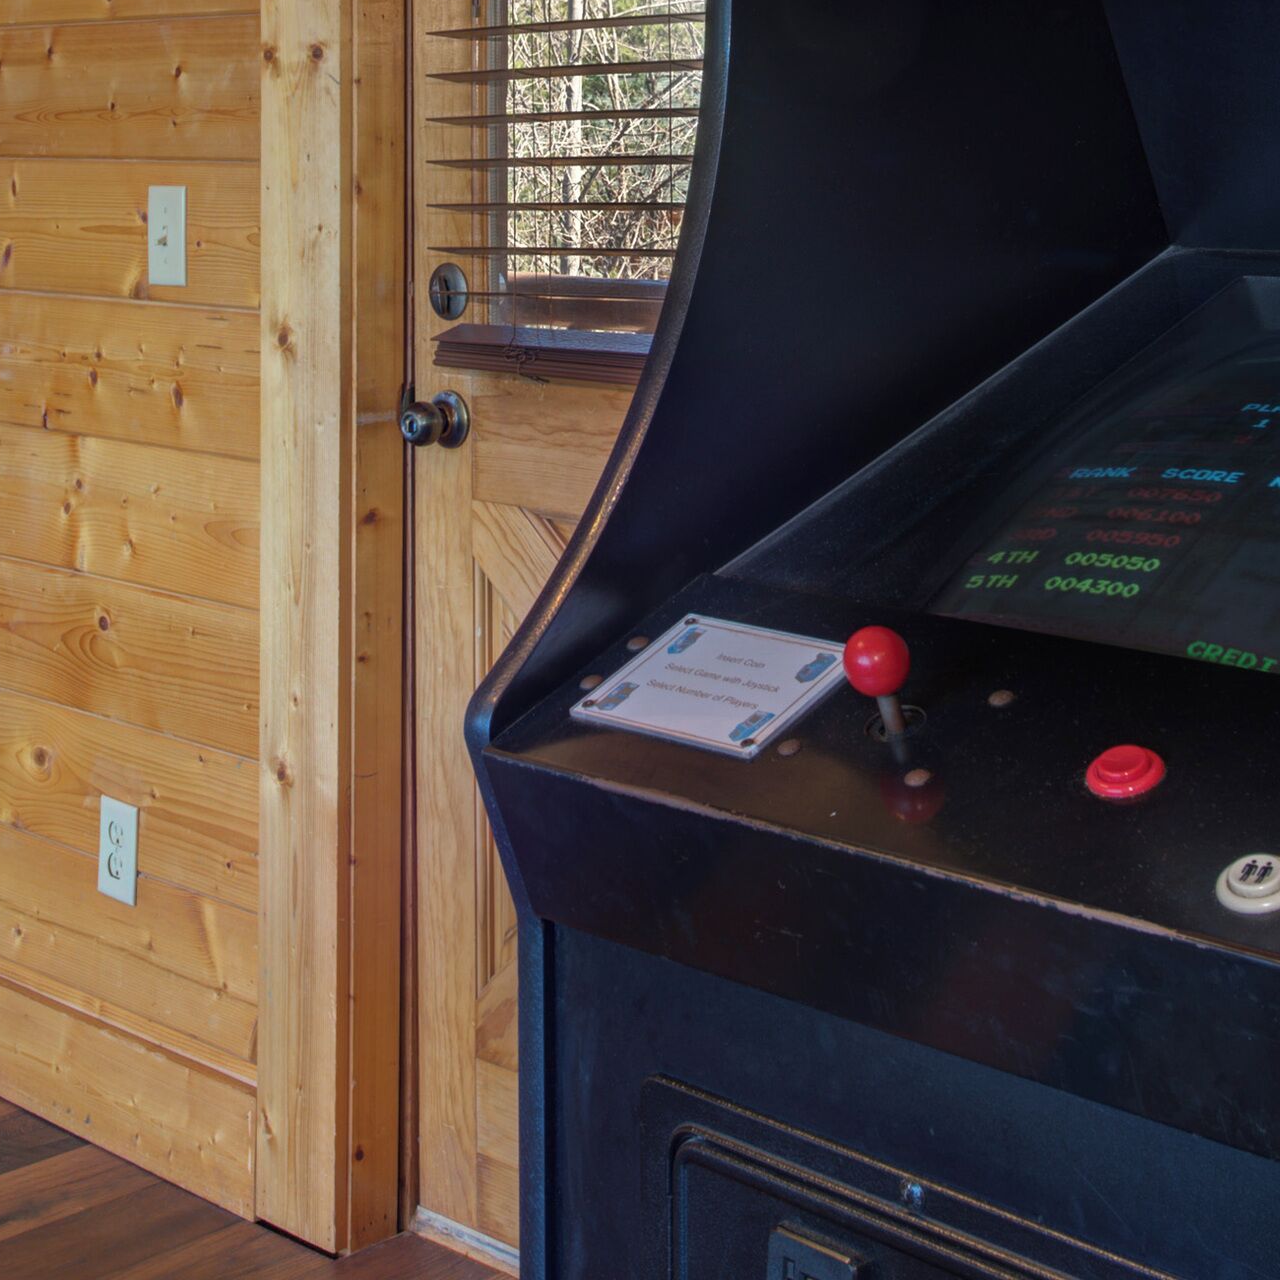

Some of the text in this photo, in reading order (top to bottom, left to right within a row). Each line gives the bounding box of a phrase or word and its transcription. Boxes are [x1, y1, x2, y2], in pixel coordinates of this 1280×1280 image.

[1252, 418, 1271, 429] 1
[1069, 466, 1136, 480] RANK
[1160, 467, 1245, 485] SCORE
[1106, 506, 1202, 526] 006100
[986, 550, 1161, 573] 4TH 005050
[964, 574, 1140, 599] 5TH 004300
[715, 652, 766, 669] Insert Coin
[665, 662, 780, 693] Select Game with Joystick
[646, 679, 676, 691] Select
[676, 685, 712, 699] Number
[723, 696, 759, 710] Players
